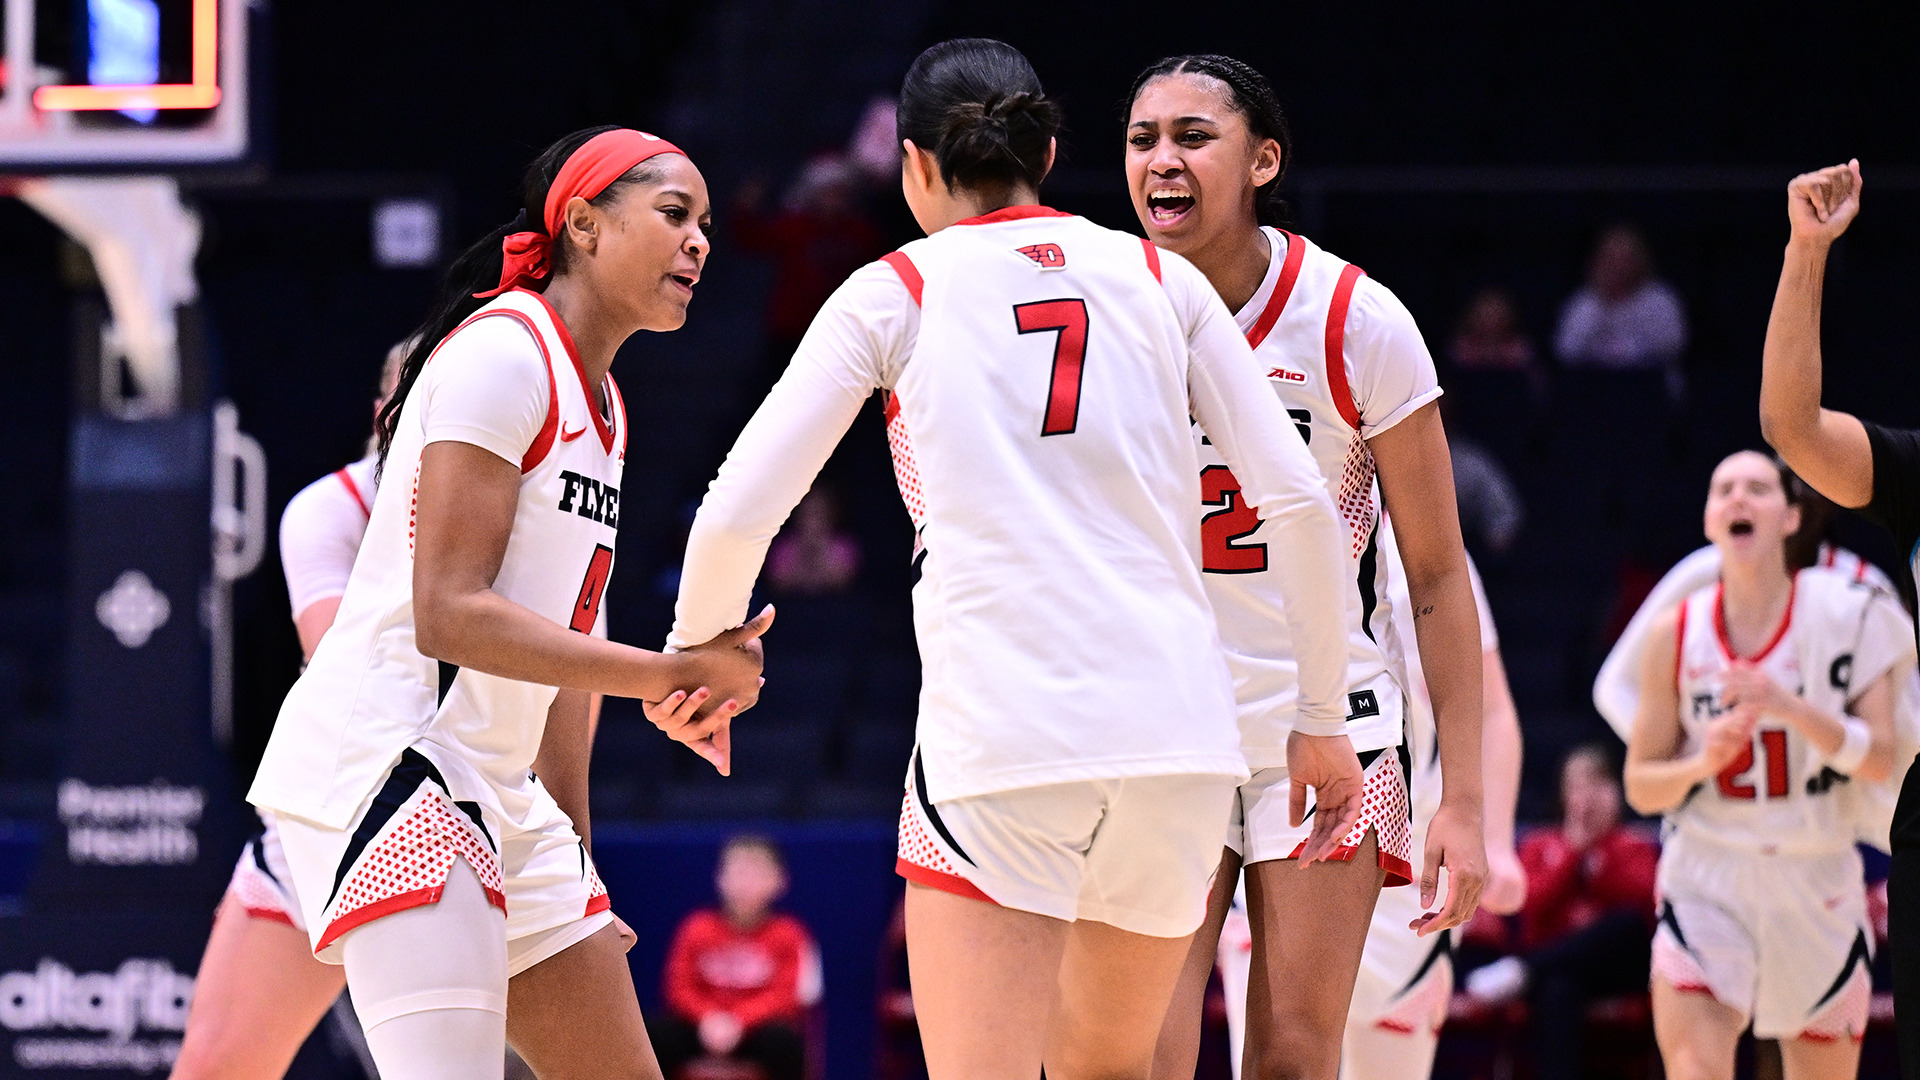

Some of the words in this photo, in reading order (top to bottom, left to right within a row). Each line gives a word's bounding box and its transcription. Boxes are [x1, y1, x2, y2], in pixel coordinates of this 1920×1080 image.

[1013, 298, 1090, 437] 7
[569, 542, 614, 636] 4
[1357, 697, 1371, 710] M
[1715, 729, 1790, 800] 21
